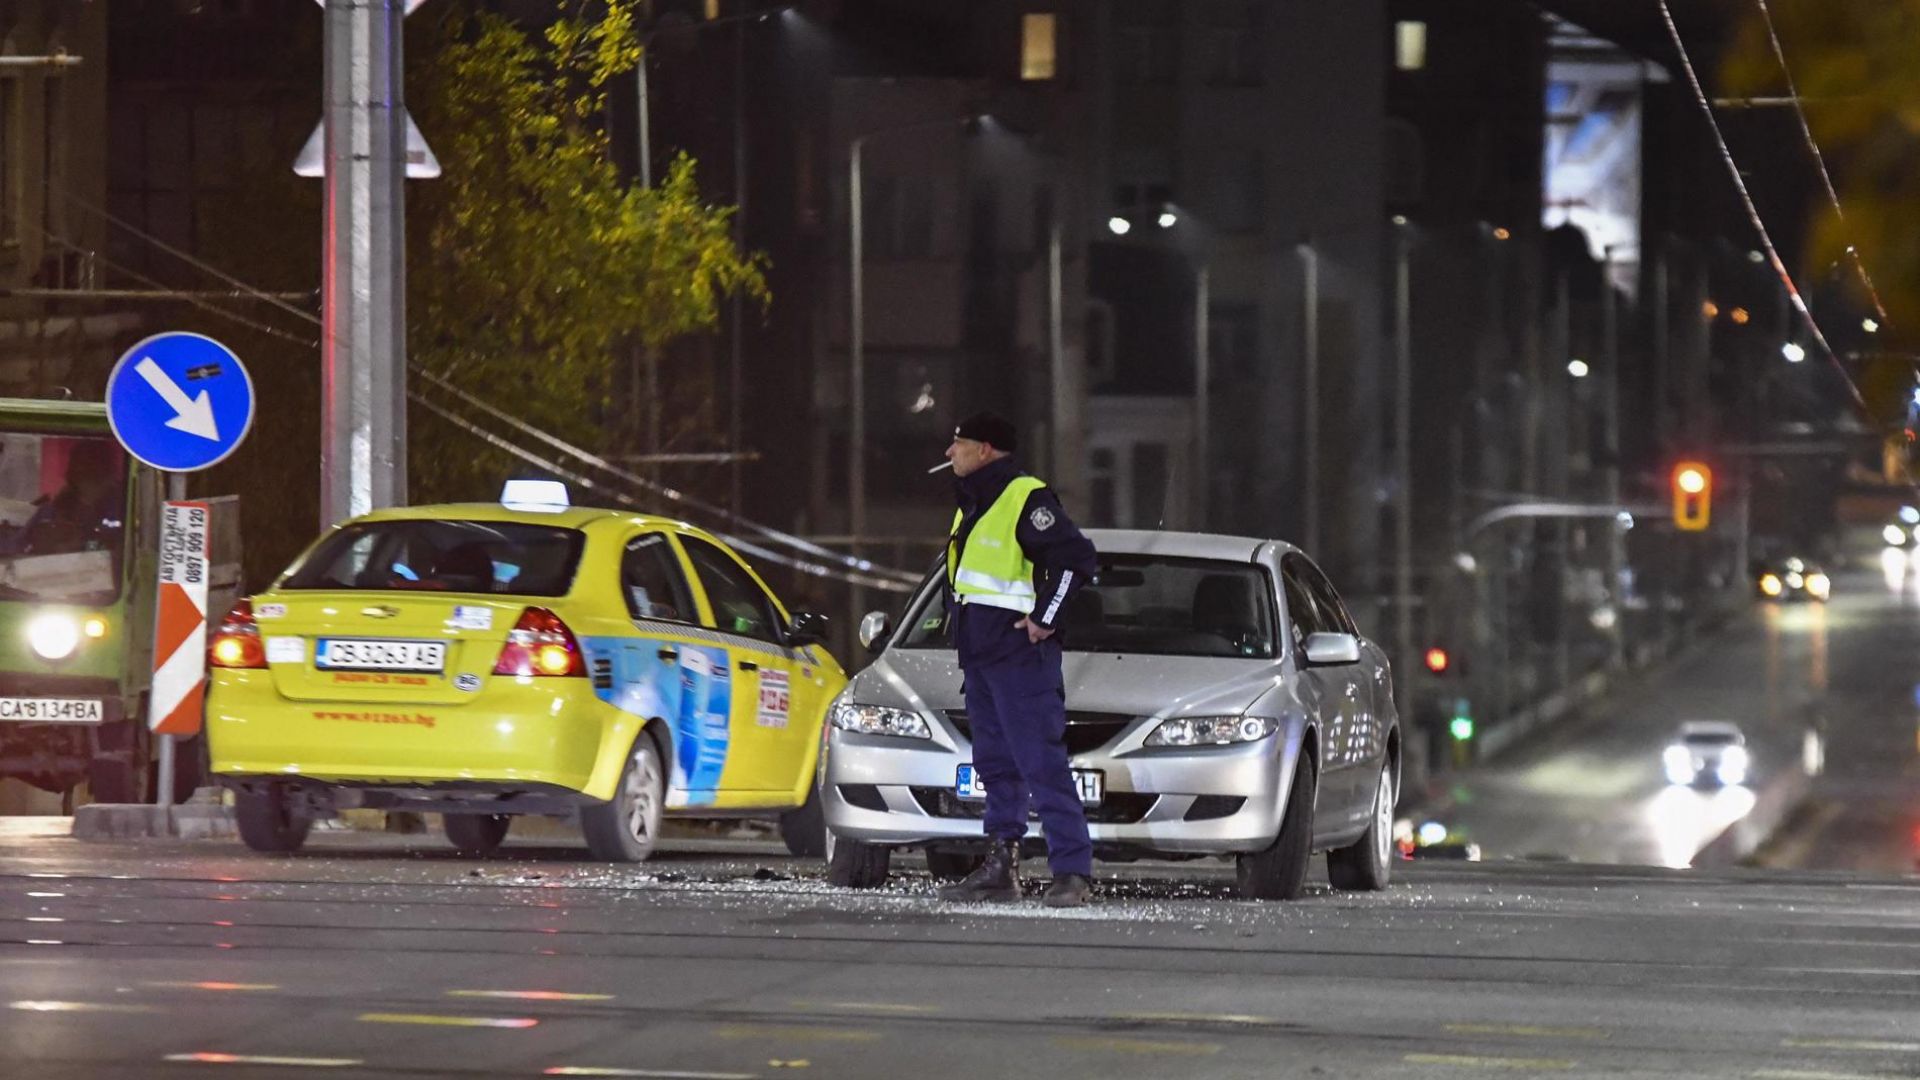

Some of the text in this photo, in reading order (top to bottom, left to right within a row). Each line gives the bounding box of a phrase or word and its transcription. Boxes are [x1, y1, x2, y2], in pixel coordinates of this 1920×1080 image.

[186, 508, 204, 583] 0897 909 120
